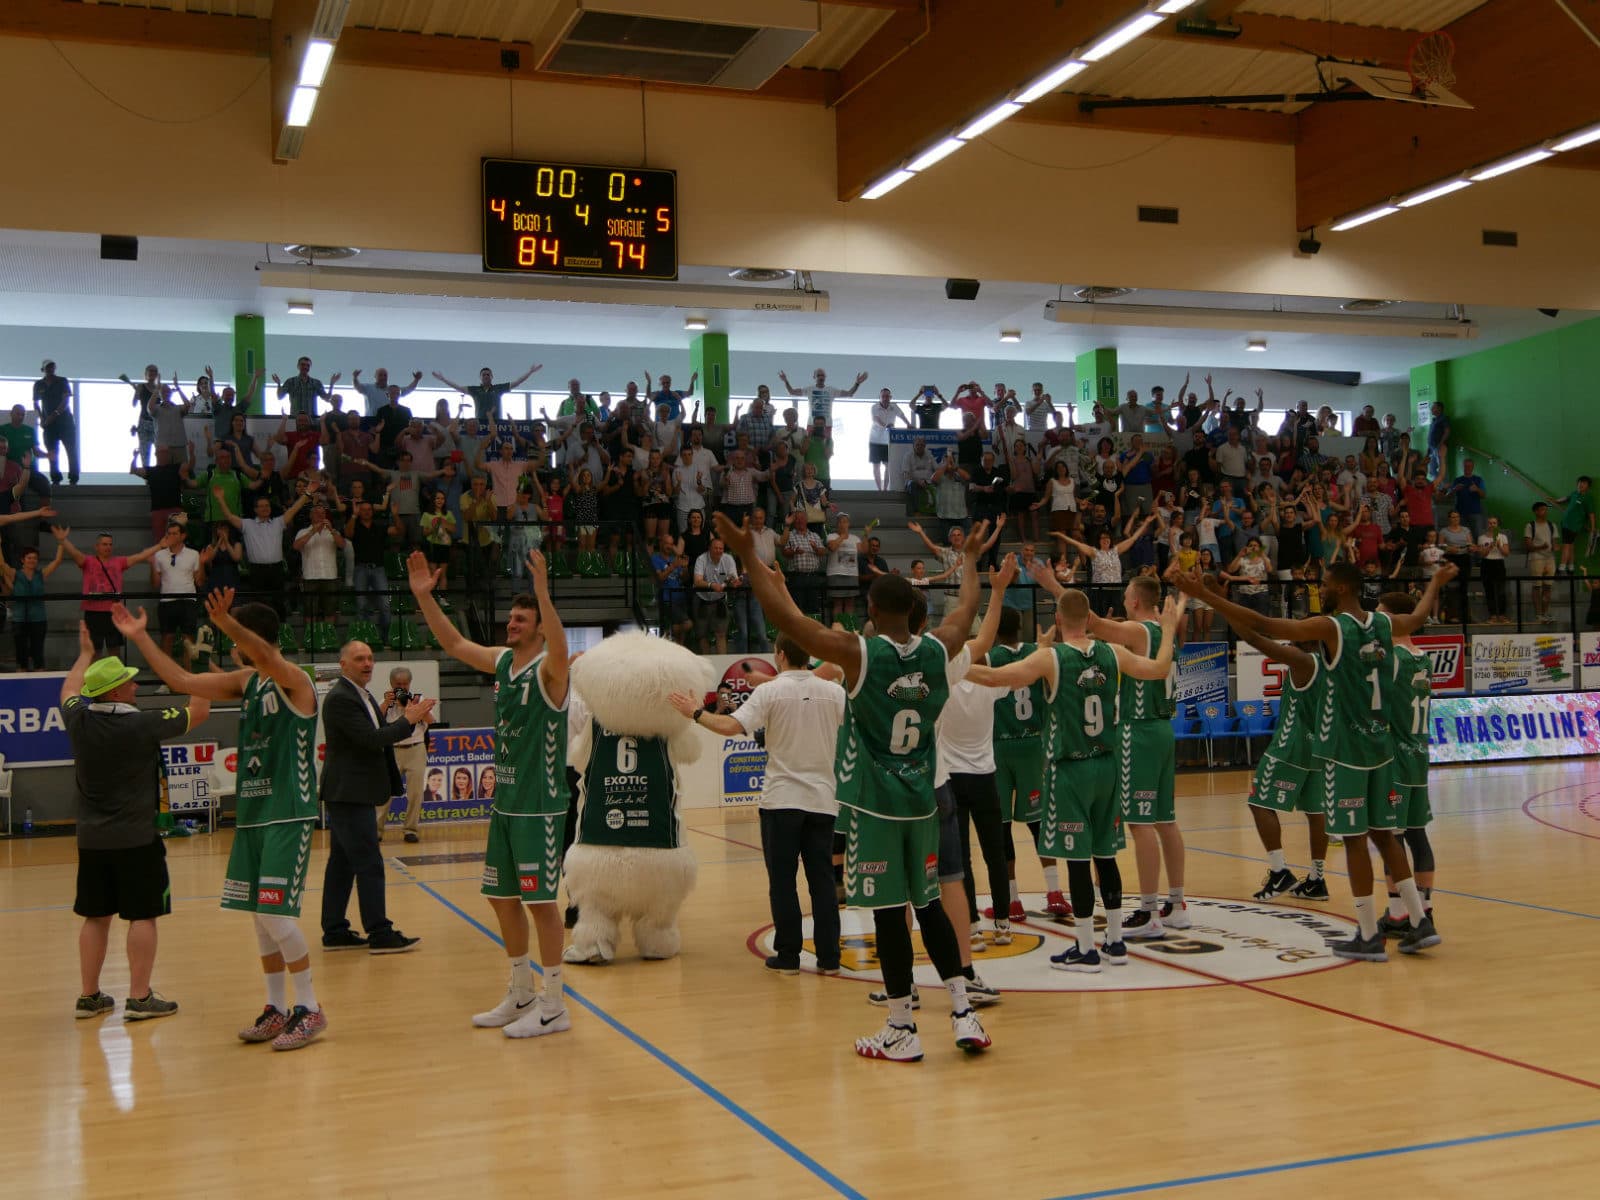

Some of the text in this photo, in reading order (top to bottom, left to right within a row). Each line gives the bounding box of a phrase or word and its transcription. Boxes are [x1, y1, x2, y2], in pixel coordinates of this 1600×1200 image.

[491, 199, 506, 221] 4
[575, 204, 590, 226] 4
[656, 208, 670, 232] 5
[513, 213, 553, 233] BCGO 1
[607, 218, 646, 238] SORGUE
[519, 236, 559, 266] 84
[609, 241, 646, 270] 74
[1082, 379, 1090, 401] H
[1100, 375, 1115, 398] H
[1366, 667, 1382, 710] 1
[1014, 687, 1033, 721] 8
[1411, 695, 1430, 734] 11
[1084, 694, 1104, 737] 9
[1454, 710, 1588, 743] MASCULINE
[890, 708, 921, 755] 6
[194, 745, 215, 762] U
[615, 736, 640, 774] 6
[604, 776, 649, 786] EXOTIC
[1276, 789, 1287, 804] 5
[1137, 801, 1152, 815] 12
[1346, 810, 1356, 827] 1
[1064, 834, 1075, 851] 9
[862, 876, 876, 897] 6
